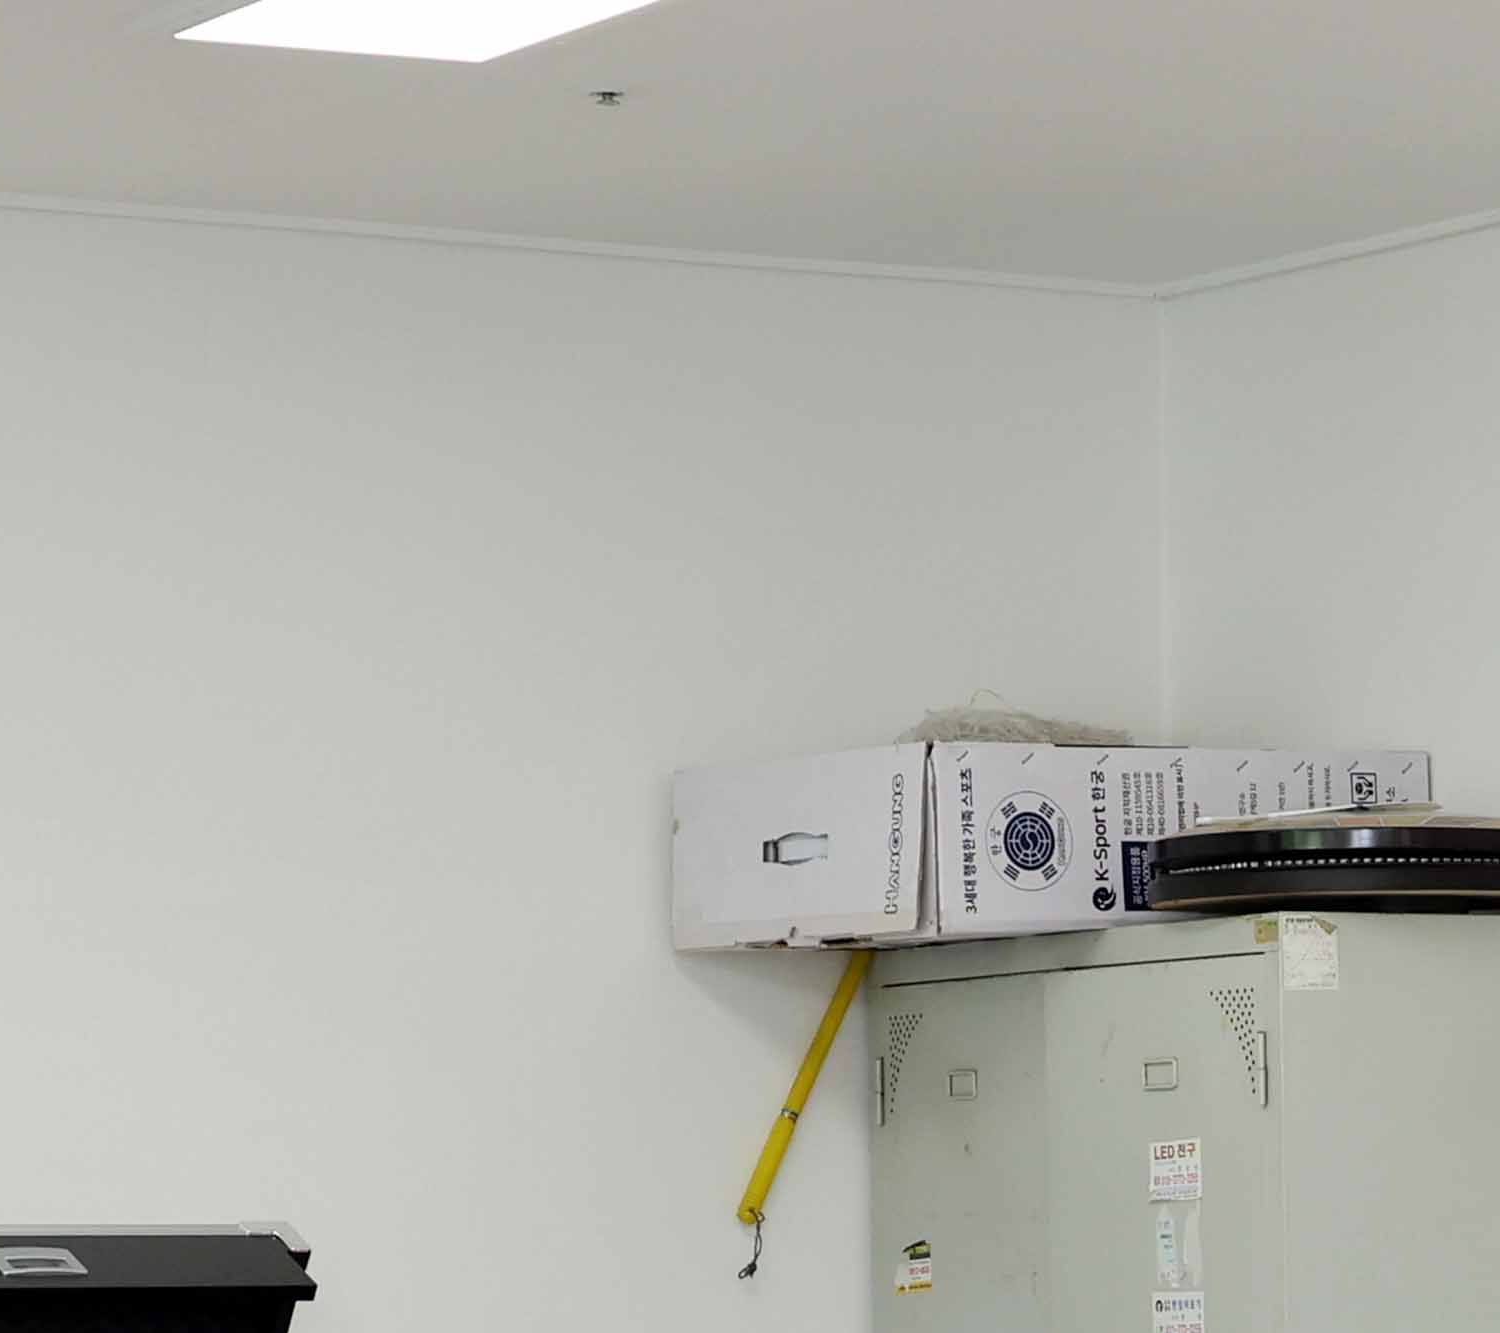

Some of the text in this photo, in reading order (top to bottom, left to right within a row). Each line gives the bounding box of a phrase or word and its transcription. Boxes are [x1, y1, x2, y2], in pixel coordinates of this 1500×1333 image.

[960, 768, 977, 913] 3세대 행복한 가족 스포츠
[1091, 770, 1111, 881] K-Sport 한궁
[1154, 1143, 1197, 1160] LED 전구
